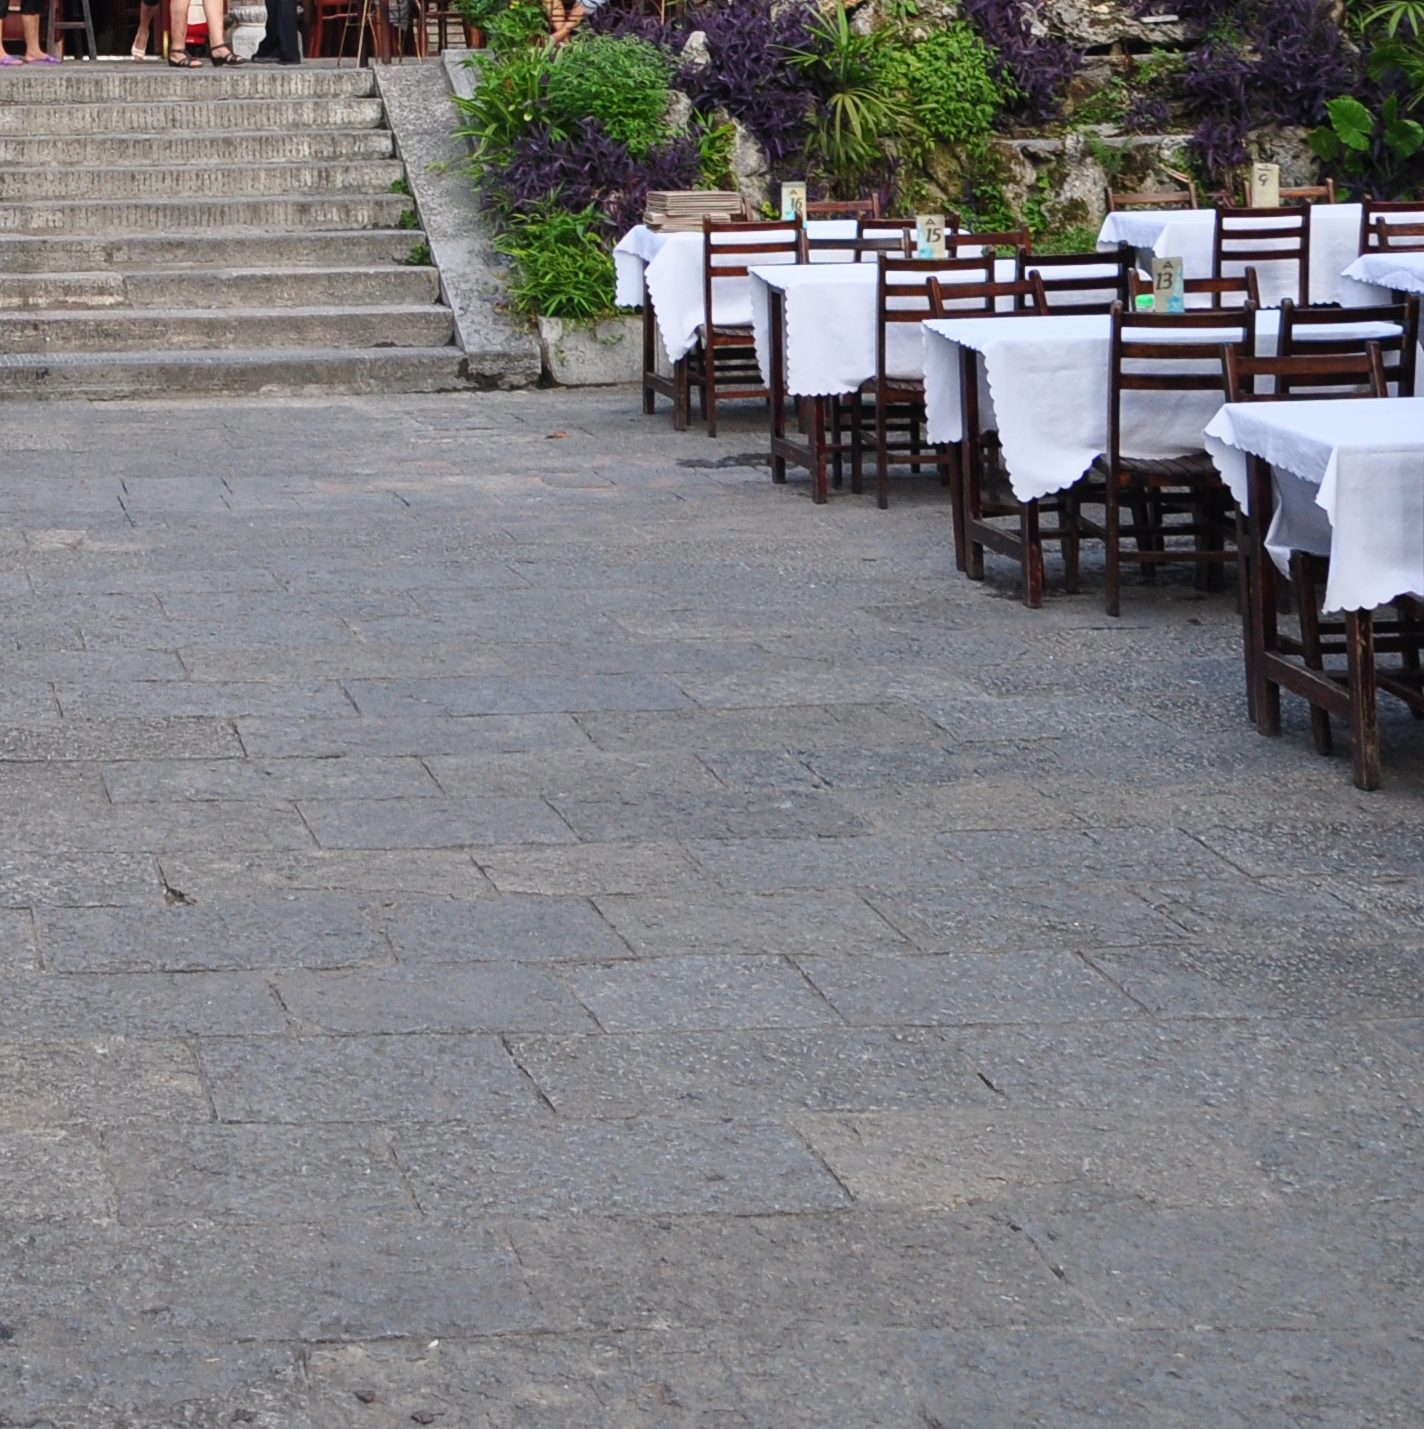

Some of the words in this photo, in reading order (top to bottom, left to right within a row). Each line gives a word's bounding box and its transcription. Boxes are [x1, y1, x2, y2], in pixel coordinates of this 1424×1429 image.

[926, 227, 942, 243] 15
[1162, 261, 1174, 270] A
[1156, 272, 1174, 291] 13
